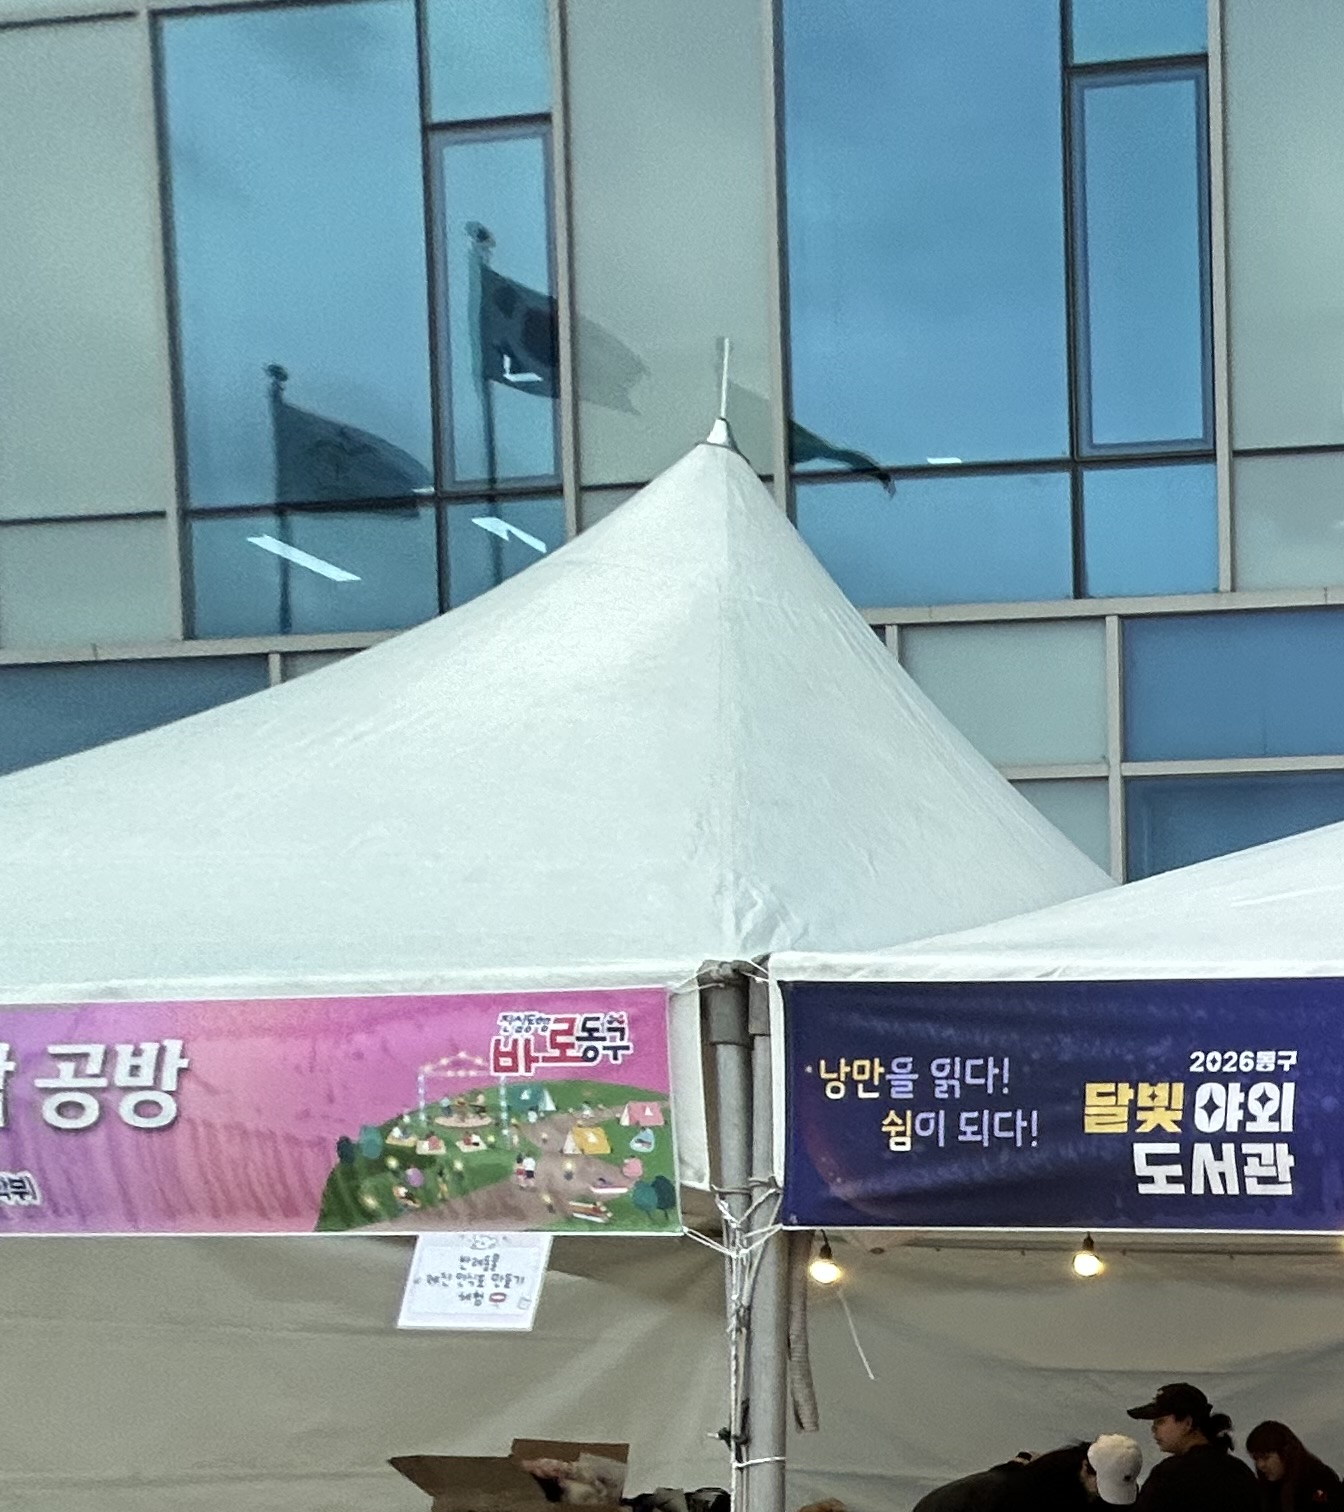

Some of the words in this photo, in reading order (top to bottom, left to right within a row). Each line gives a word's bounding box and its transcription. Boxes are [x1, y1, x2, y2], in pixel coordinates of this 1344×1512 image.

[34, 1039, 190, 1130] 공방
[818, 1055, 919, 1100] 낭만을
[930, 1055, 1010, 1099] 읽다!
[1189, 1050, 1298, 1073] 2026동구
[880, 1109, 947, 1152] 쉼이
[957, 1109, 1039, 1148] 되다!
[1083, 1081, 1185, 1134] 달빛
[1193, 1081, 1296, 1134] 야외
[1133, 1141, 1296, 1196] 도서관
